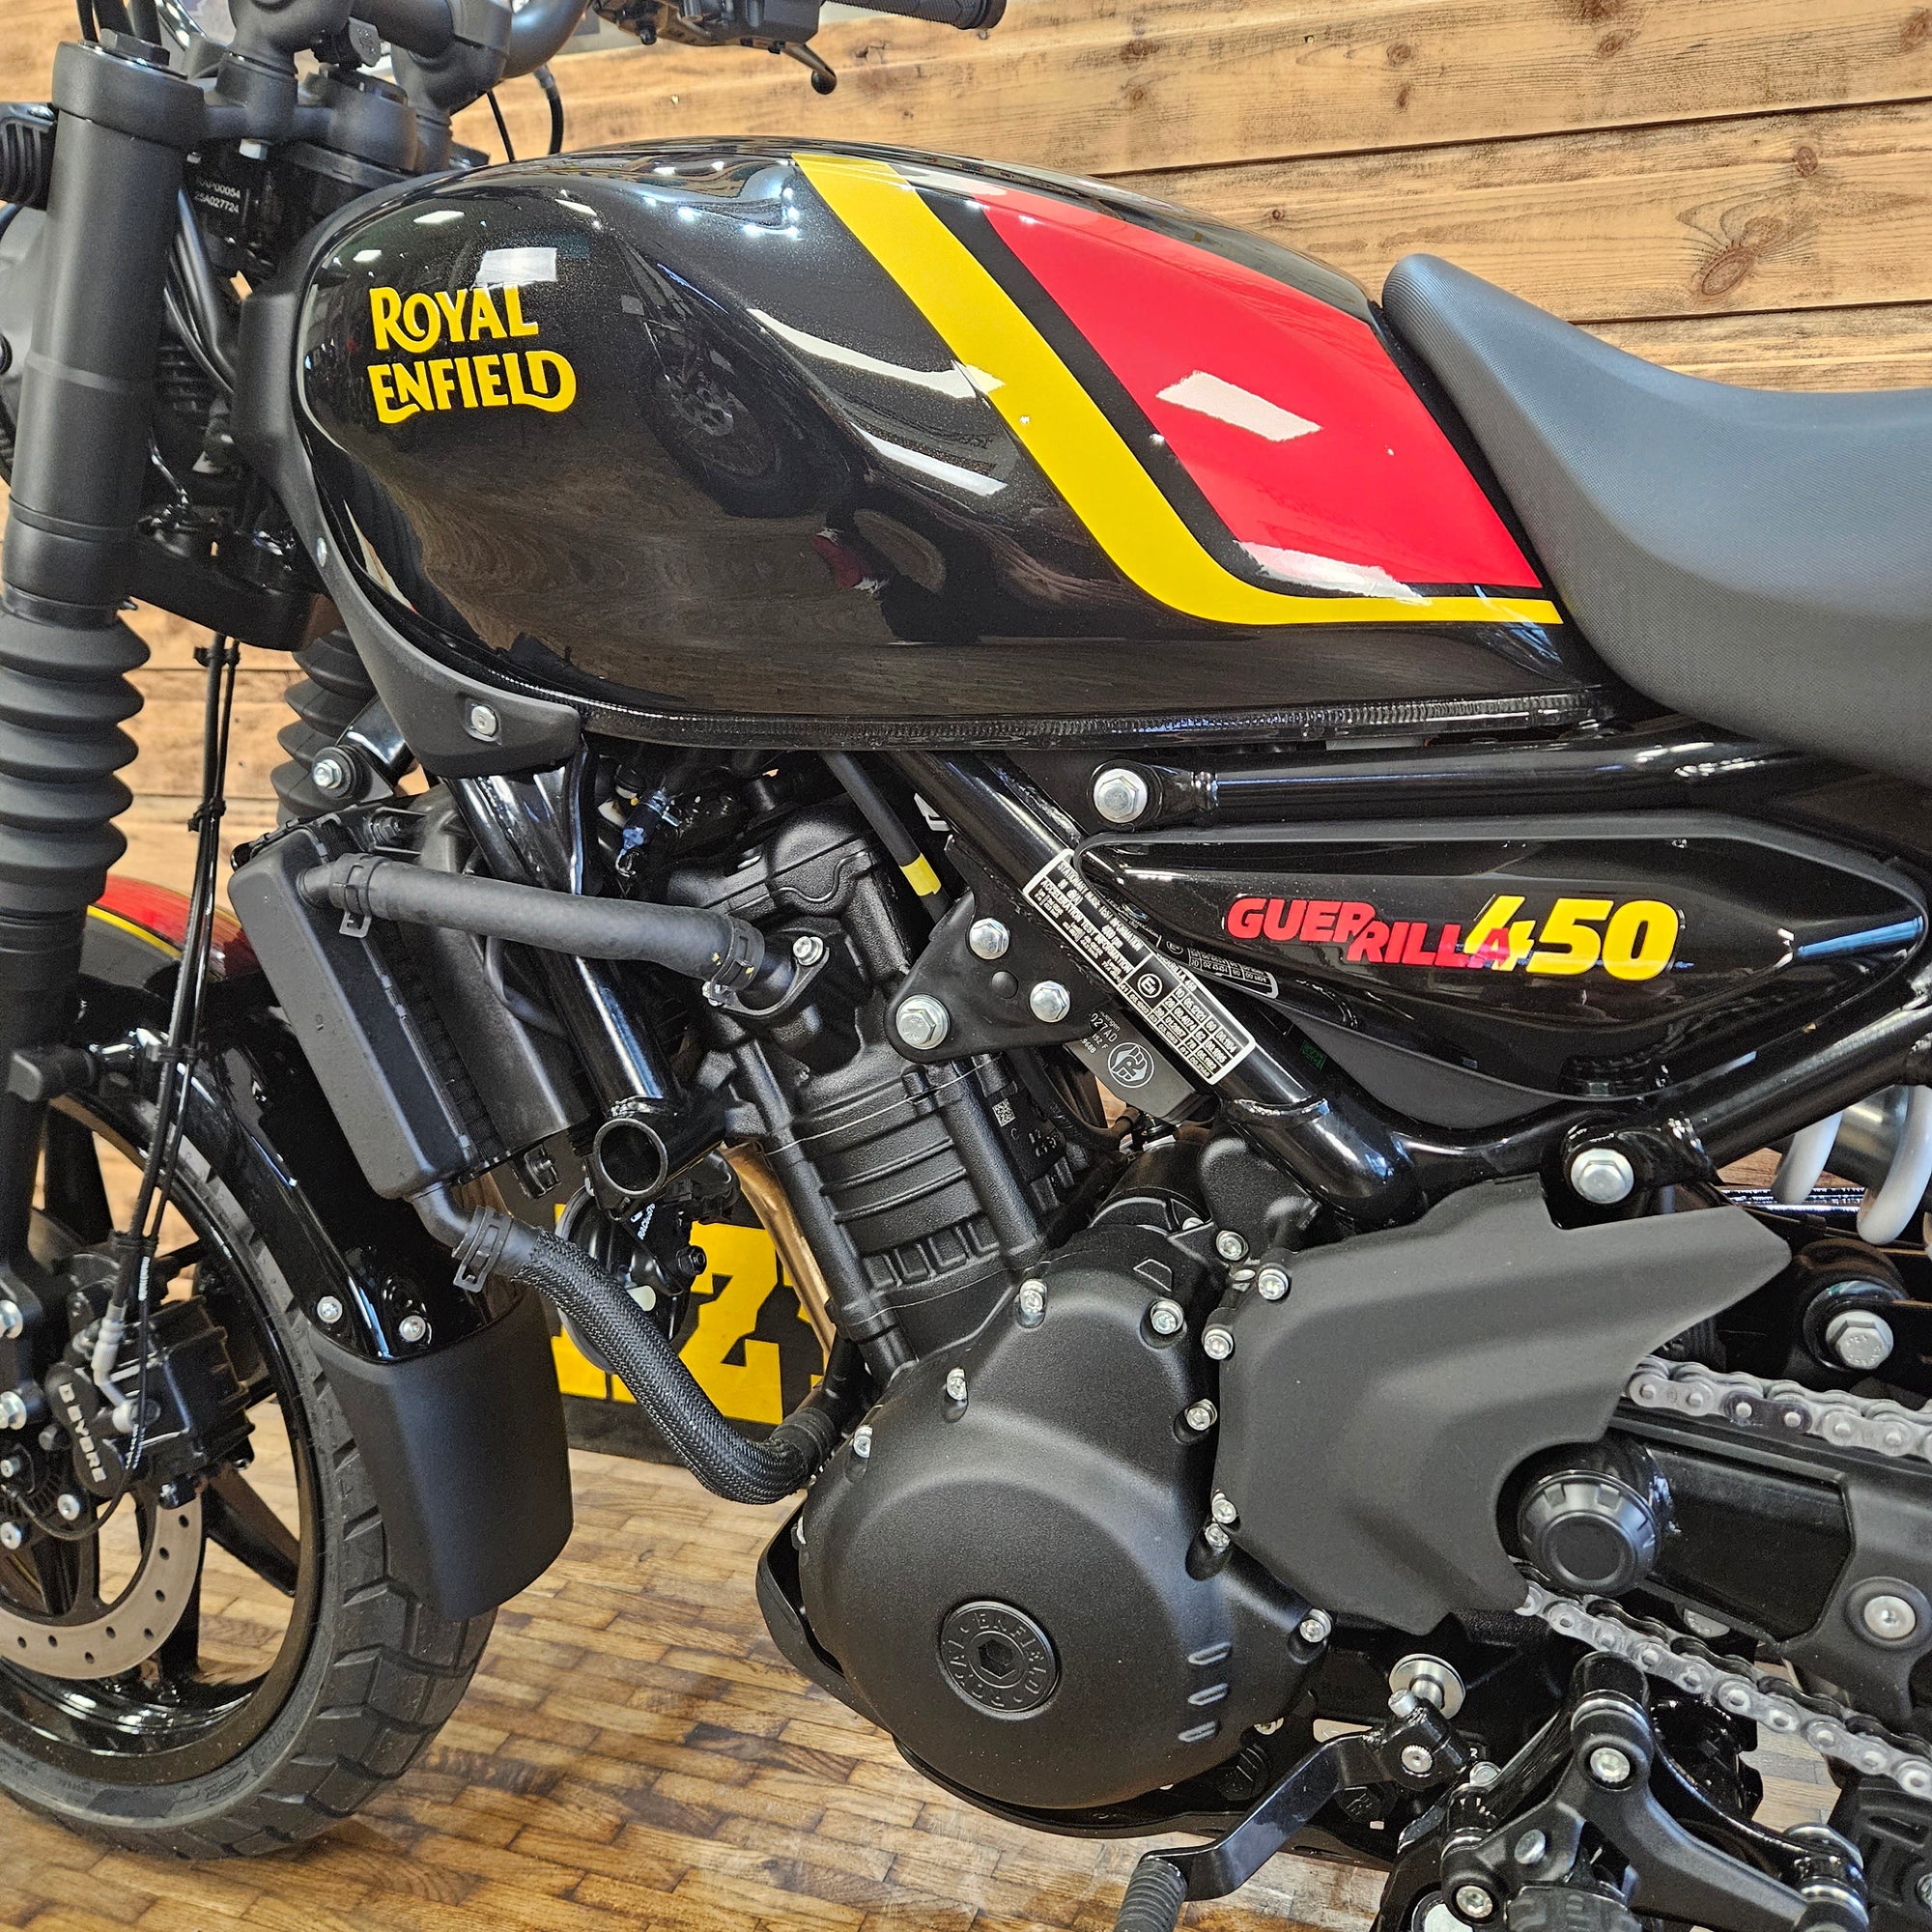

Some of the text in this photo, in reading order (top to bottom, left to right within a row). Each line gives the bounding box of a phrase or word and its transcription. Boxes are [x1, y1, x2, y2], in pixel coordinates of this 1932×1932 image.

[369, 283, 538, 353] ROYAL
[367, 351, 577, 423] ENFIELD
[1040, 878, 1082, 923] ACCELERATION
[1080, 920, 1096, 936] TEST
[1094, 933, 1132, 974] INFORMATION
[1109, 916, 1143, 952] INFORMATION
[1227, 898, 1511, 969] GUERRILLA
[1464, 895, 1680, 980] 450
